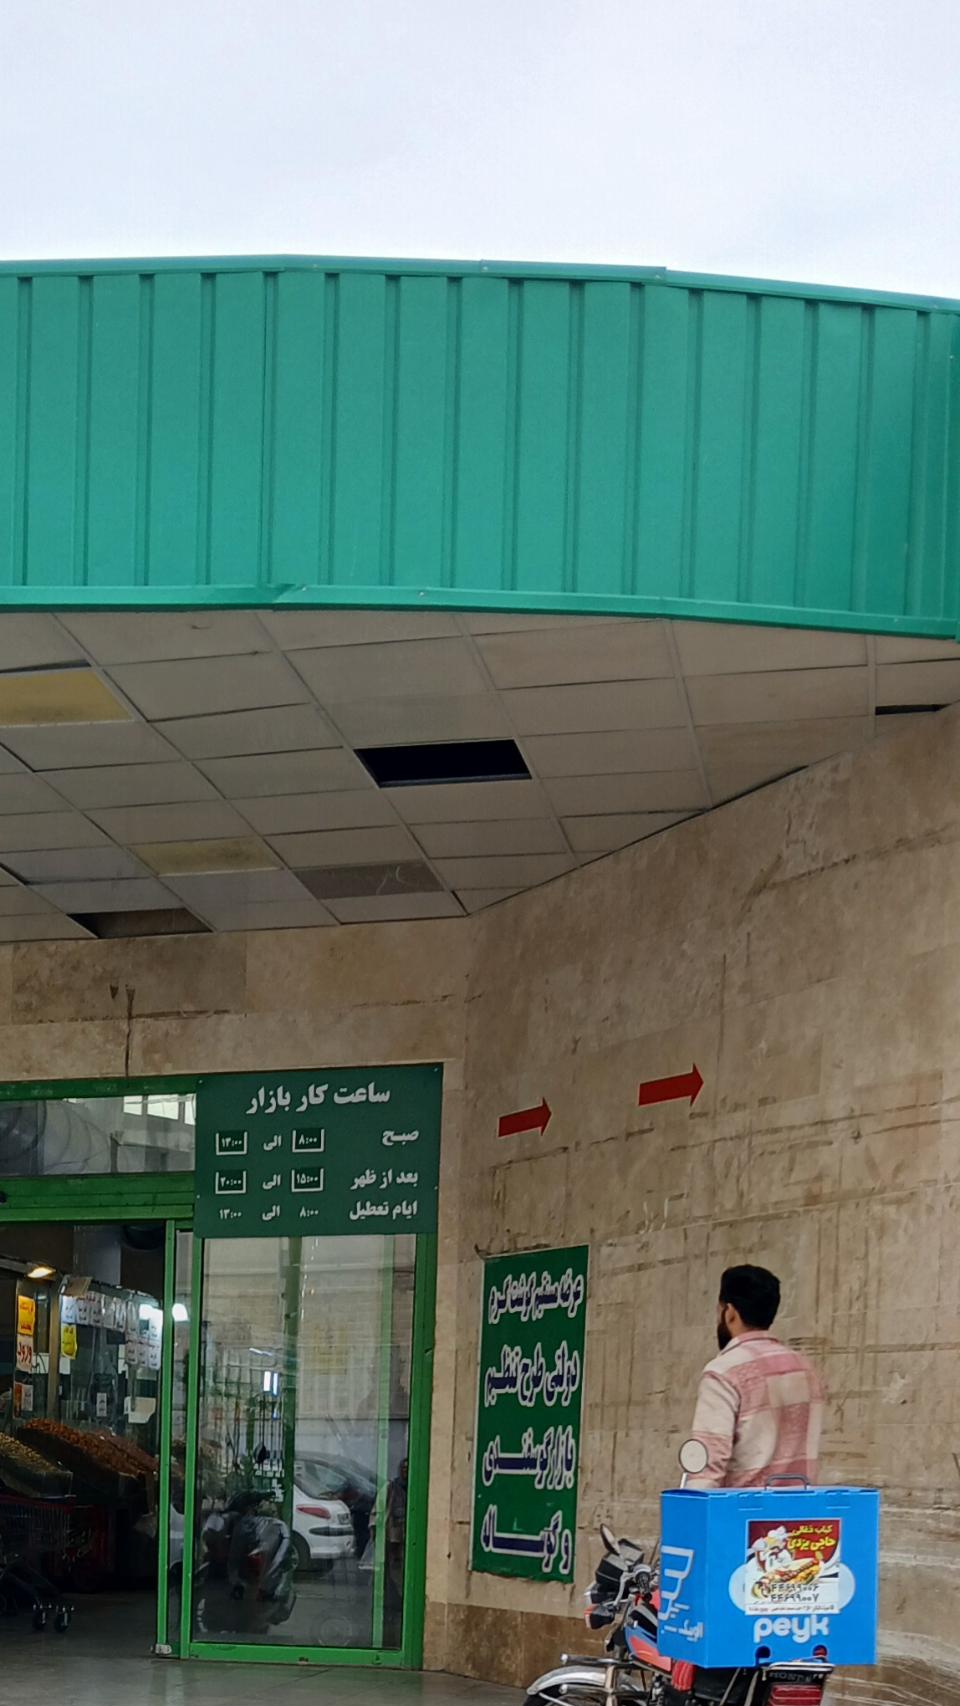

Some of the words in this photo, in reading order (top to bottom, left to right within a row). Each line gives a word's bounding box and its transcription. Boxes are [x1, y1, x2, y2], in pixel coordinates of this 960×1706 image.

[246, 1085, 291, 1114] بازار
[296, 1084, 329, 1112] کار
[333, 1082, 391, 1104] ساعت
[263, 1134, 282, 1151] الی
[382, 1129, 420, 1147] صبح
[262, 1174, 281, 1190] الی
[350, 1169, 377, 1190] ظهر
[379, 1170, 393, 1189] از
[396, 1169, 419, 1187] بعد
[261, 1205, 281, 1221] الی
[349, 1201, 389, 1221] تعطیل
[392, 1200, 418, 1220] ایام
[484, 1344, 522, 1408] تنظیم
[518, 1341, 546, 1407] طرح
[543, 1340, 580, 1407] دولتی
[482, 1426, 555, 1489] گوسفندی
[548, 1424, 576, 1491] بازار
[481, 1504, 563, 1573] گوساله
[786, 1538, 810, 1552] یزدی
[810, 1536, 836, 1551] حاجی
[559, 1528, 572, 1575] و
[753, 1615, 830, 1644] peyk
